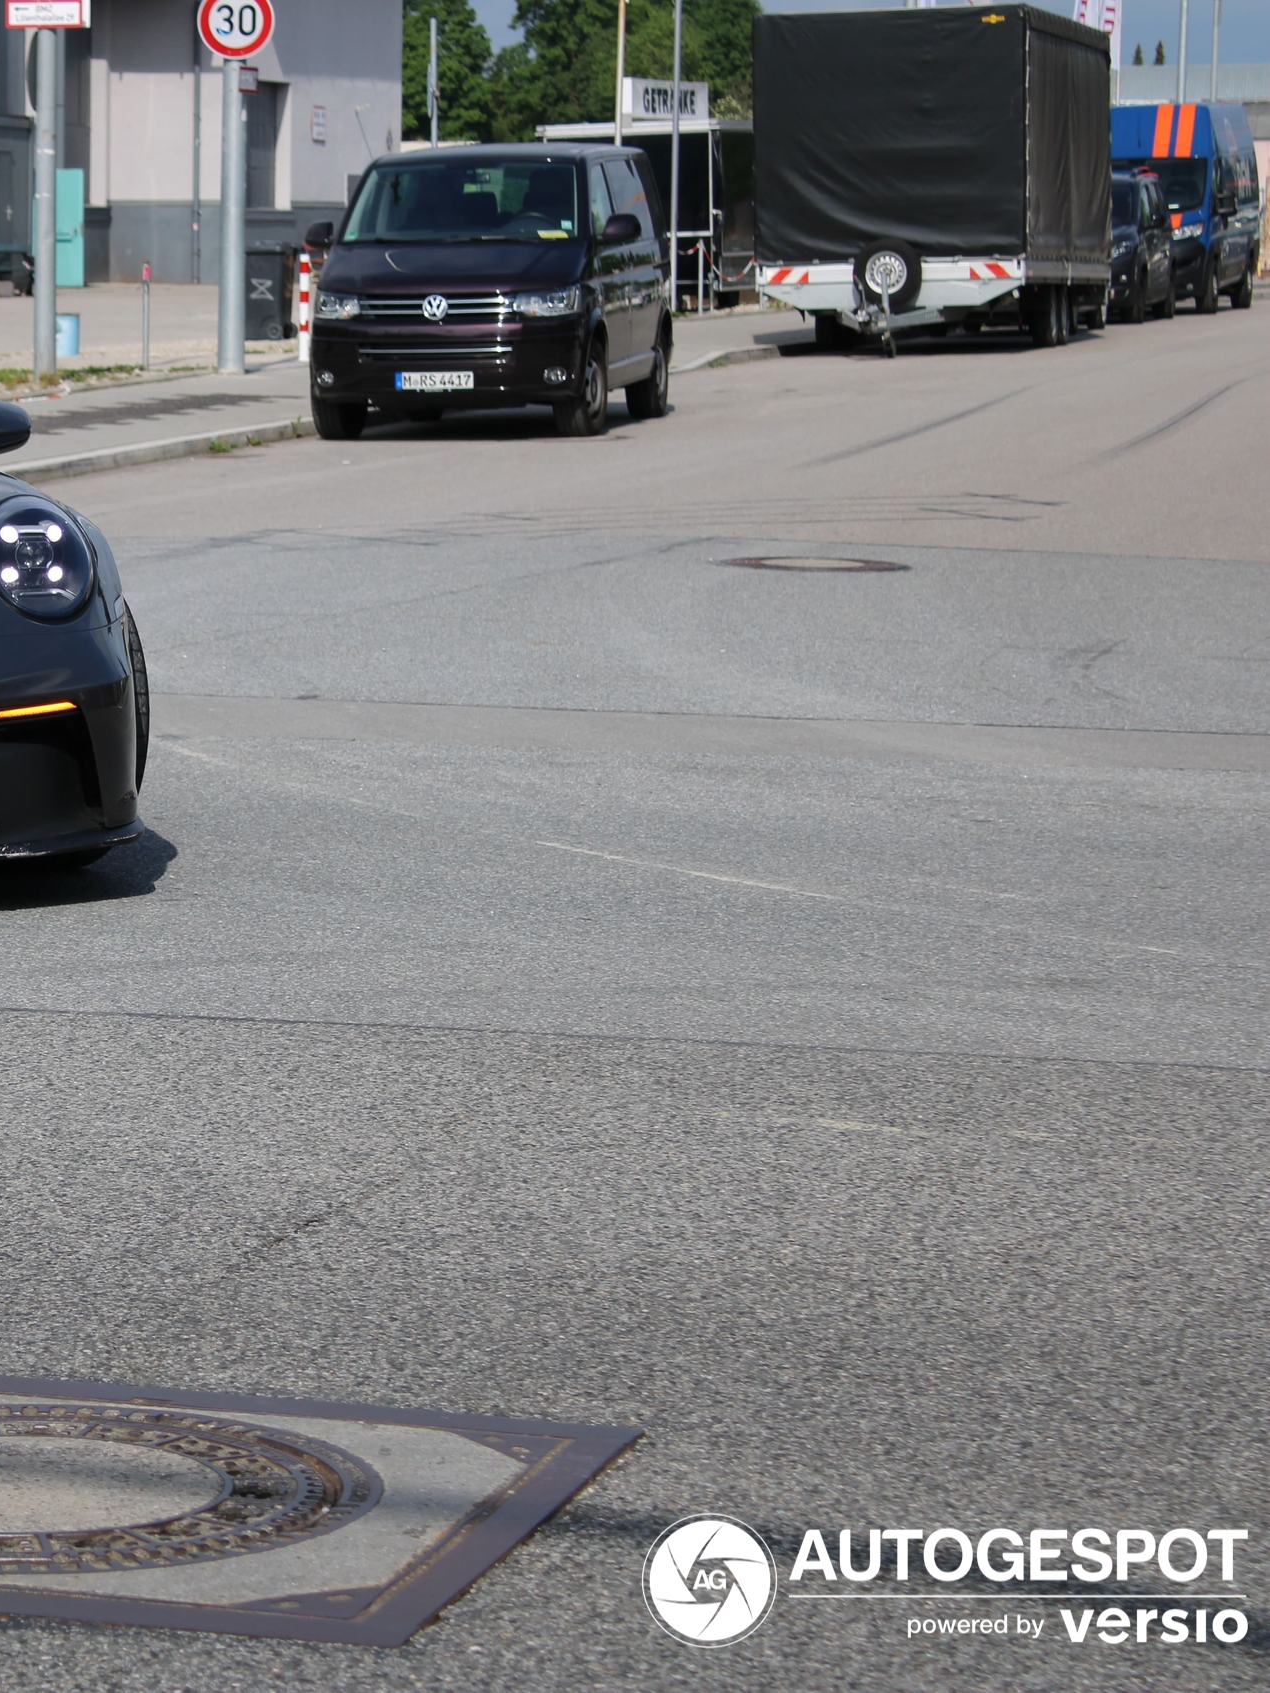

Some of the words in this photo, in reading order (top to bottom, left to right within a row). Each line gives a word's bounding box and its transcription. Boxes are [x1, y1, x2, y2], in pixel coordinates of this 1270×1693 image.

[216, 5, 256, 35] 30
[403, 375, 411, 387] M
[420, 374, 436, 387] RS
[440, 374, 471, 386] 4417
